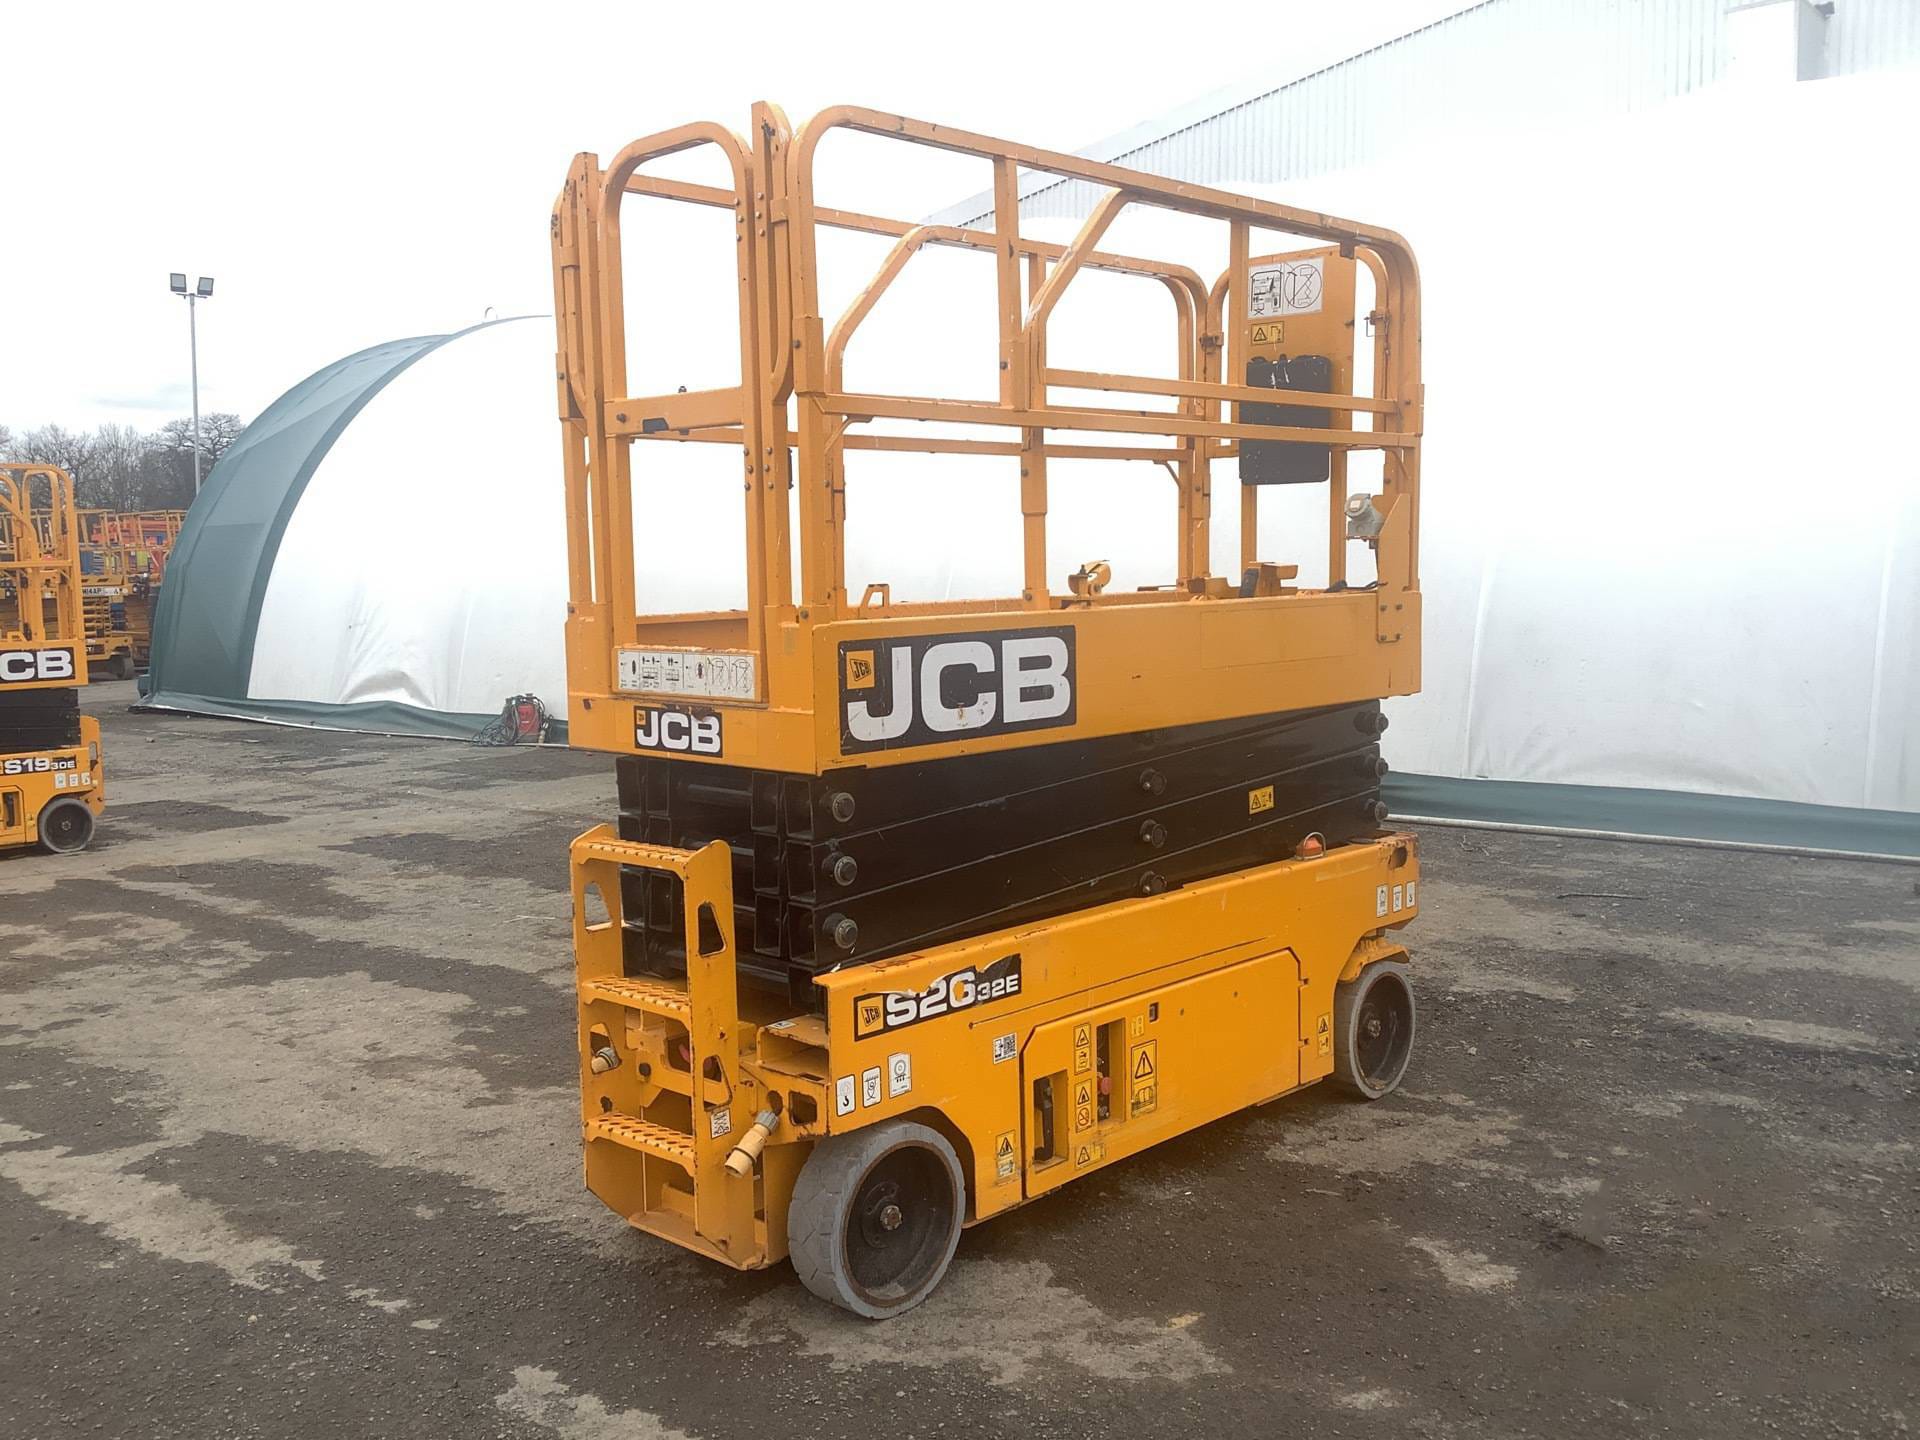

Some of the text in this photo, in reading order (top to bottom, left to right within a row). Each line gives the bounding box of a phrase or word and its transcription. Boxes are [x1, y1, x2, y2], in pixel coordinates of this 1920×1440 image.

[0, 650, 73, 681] CB
[854, 660, 870, 679] JCB
[847, 636, 1071, 741] JCB
[636, 711, 721, 753] JCB
[864, 1007, 880, 1024] JCB
